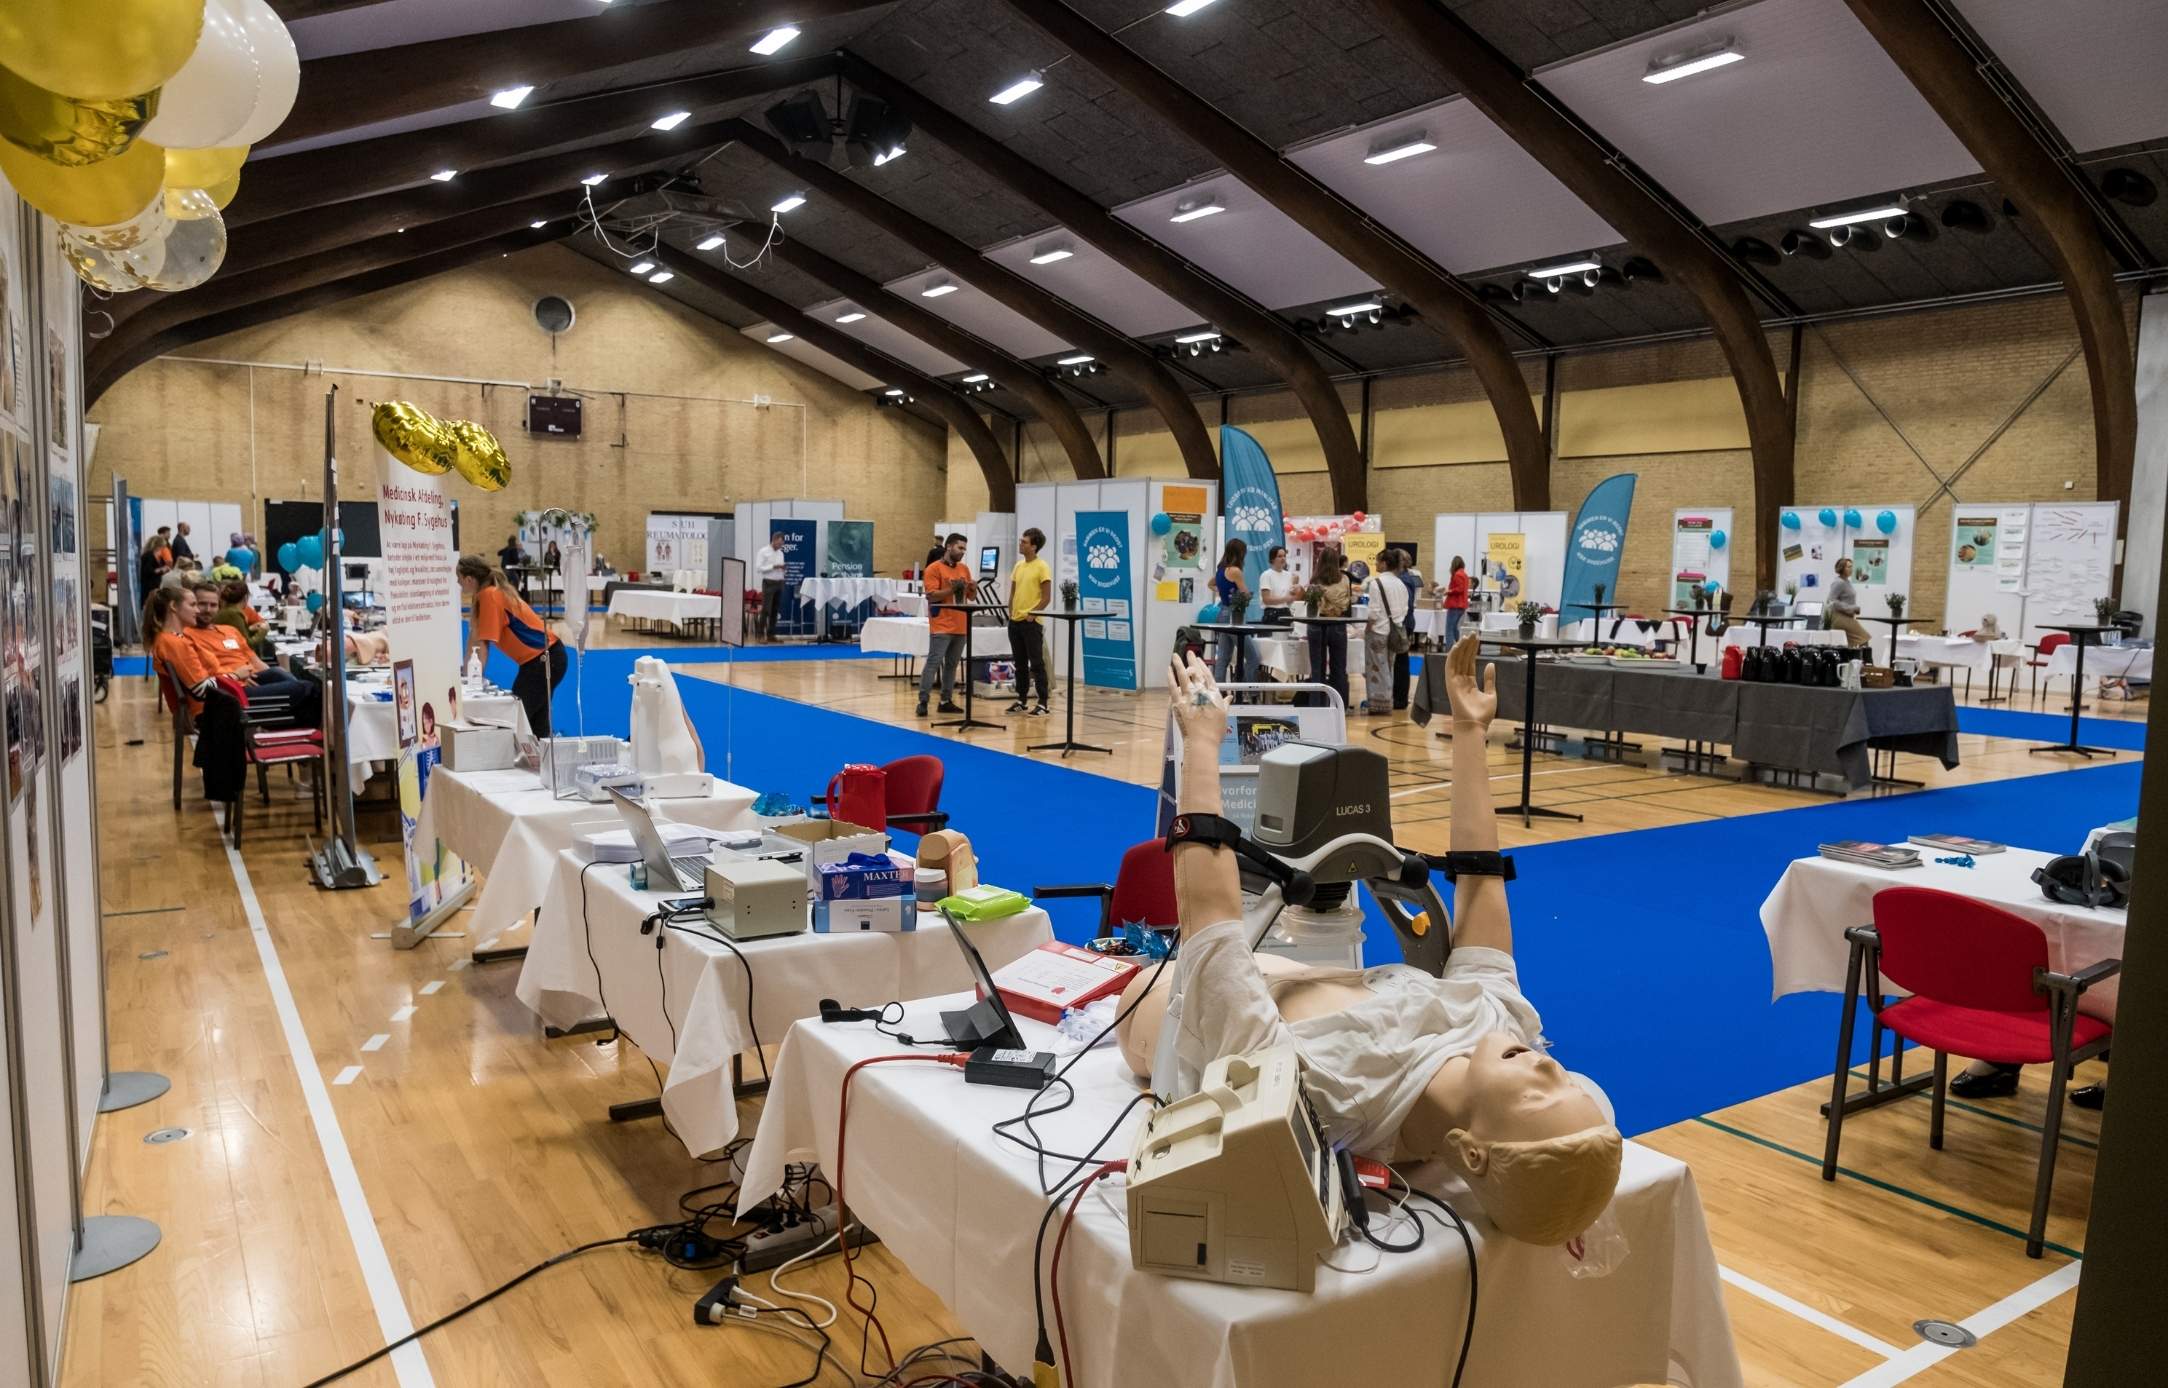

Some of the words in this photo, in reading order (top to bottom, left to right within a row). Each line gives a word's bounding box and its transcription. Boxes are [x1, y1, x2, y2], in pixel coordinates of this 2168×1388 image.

[832, 562, 863, 570] Pension
[1336, 805, 1365, 816] LUCAS
[1365, 804, 1371, 813] 3
